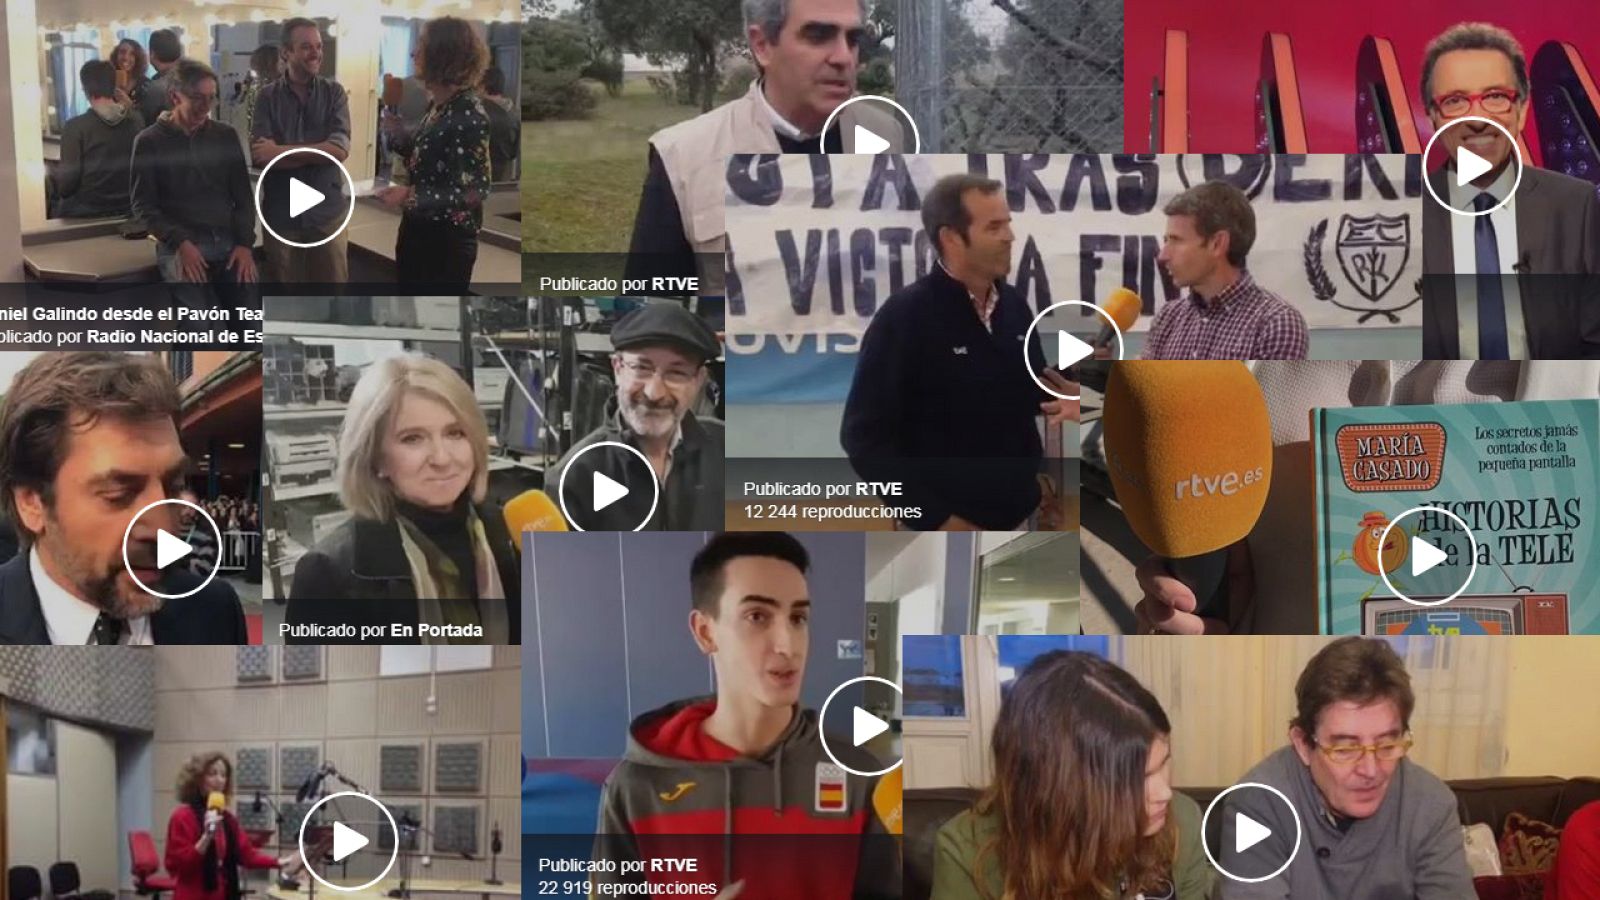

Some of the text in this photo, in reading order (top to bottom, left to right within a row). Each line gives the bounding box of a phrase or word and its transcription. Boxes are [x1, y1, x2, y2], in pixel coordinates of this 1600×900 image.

[1475, 423, 1579, 440] Los secretos jamás
[1356, 433, 1426, 458] MARÍA
[1486, 438, 1567, 456] contados de la
[1352, 458, 1431, 483] CASADO
[1478, 454, 1577, 474] pequeña pantalla
[1175, 467, 1263, 500] rtve.es
[1419, 497, 1581, 534] HISTORIAS
[1499, 533, 1575, 566] TELE
